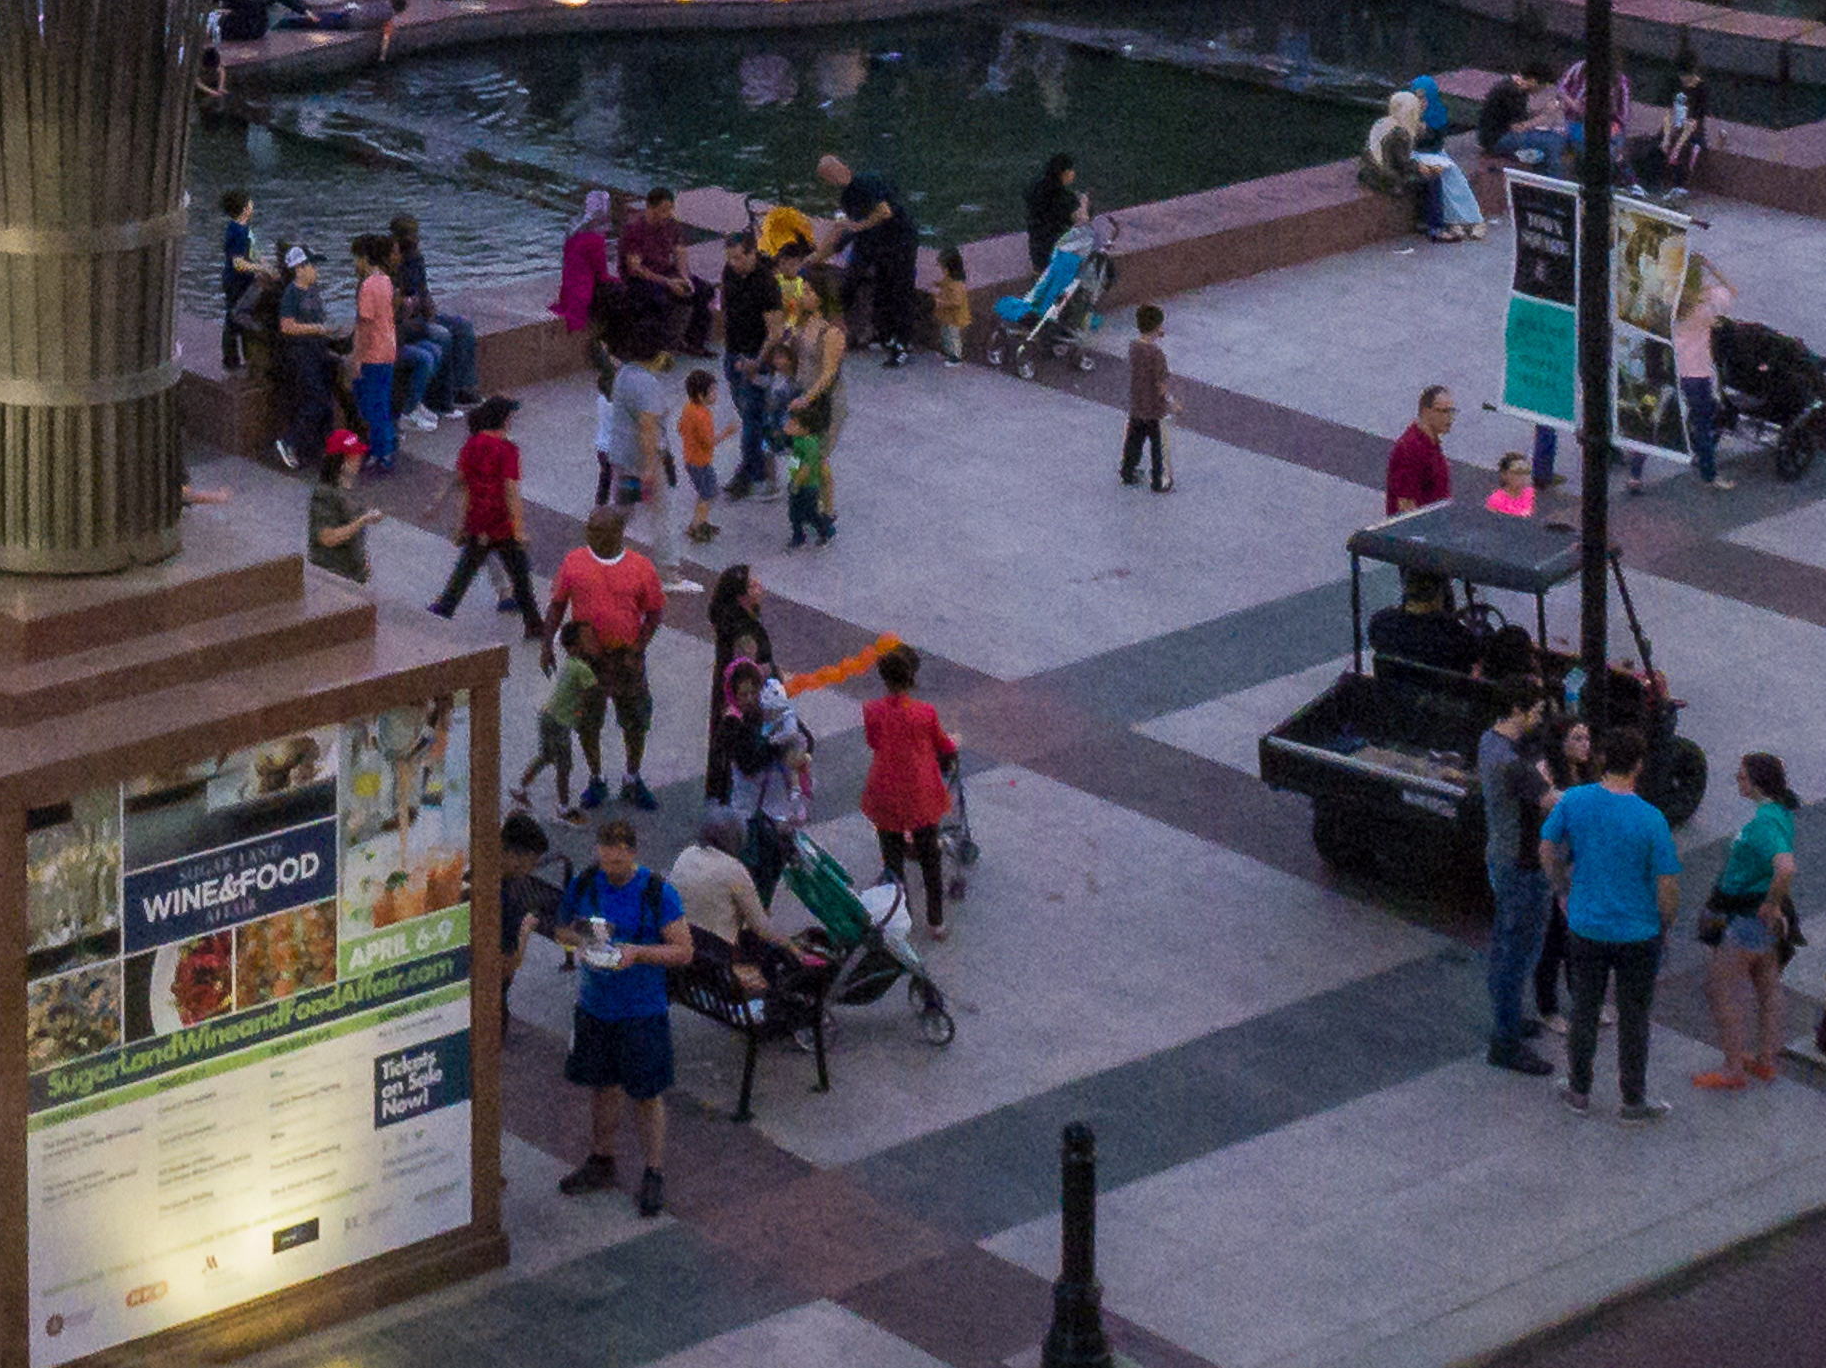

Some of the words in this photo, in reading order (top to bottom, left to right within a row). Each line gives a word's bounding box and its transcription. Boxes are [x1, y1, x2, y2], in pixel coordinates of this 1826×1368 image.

[238, 841, 284, 867] LAND
[142, 851, 321, 923] WINE&FOOD
[348, 932, 410, 972] APRIL
[415, 919, 454, 951] 6-9
[381, 1050, 437, 1080] Tickets
[381, 1081, 404, 1098] on
[408, 1064, 444, 1092] Sale
[381, 1087, 430, 1119] Now!
